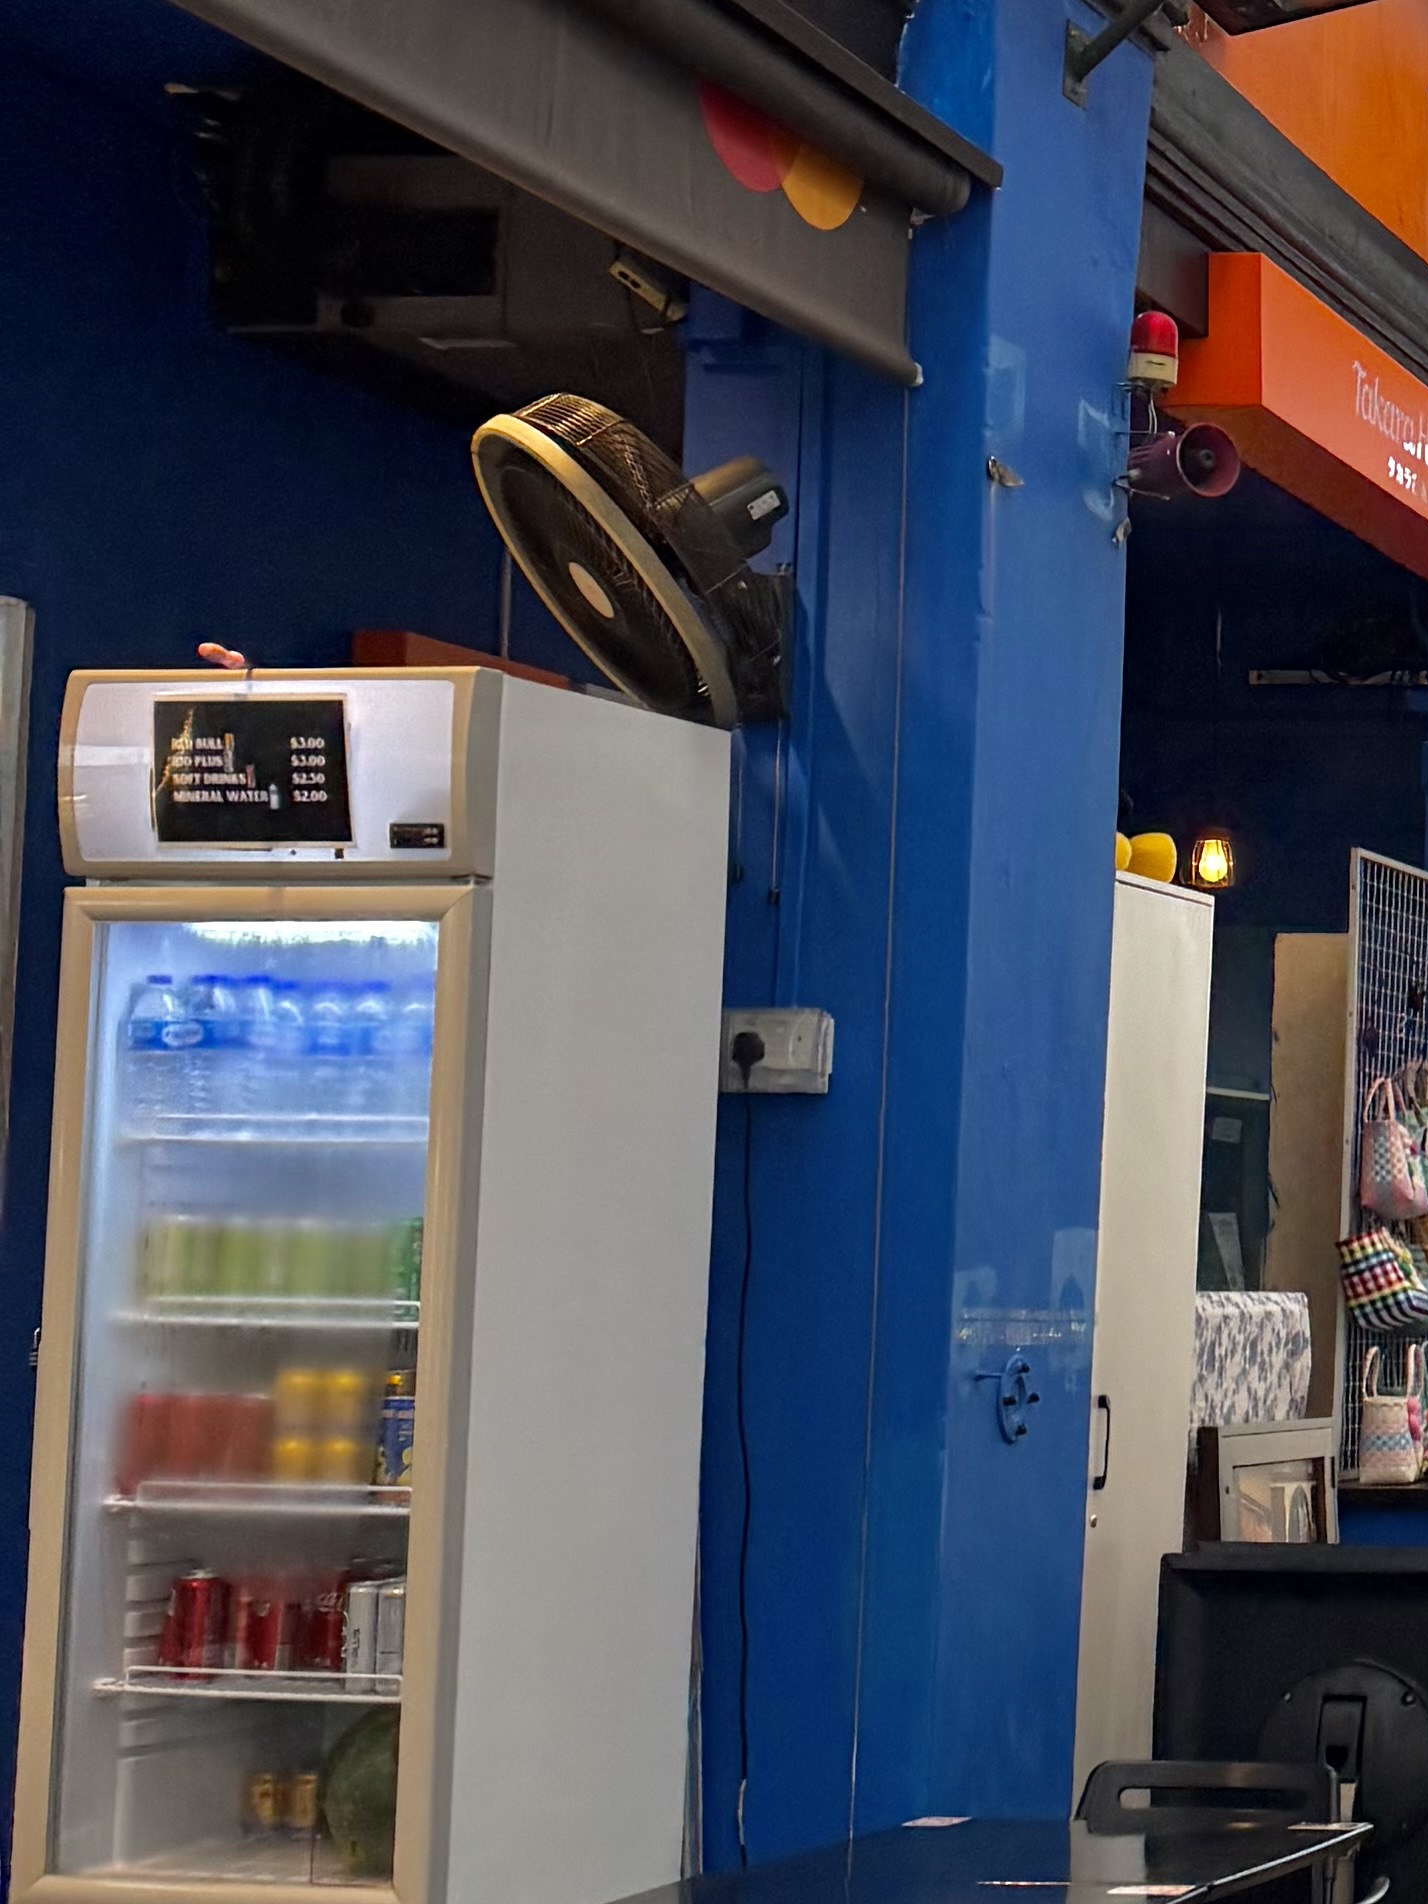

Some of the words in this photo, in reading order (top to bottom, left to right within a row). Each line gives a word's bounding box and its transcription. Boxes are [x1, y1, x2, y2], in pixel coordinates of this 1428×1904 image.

[195, 737, 223, 750] BULL
[195, 755, 223, 767] PLUS
[172, 773, 199, 786] SOFT
[203, 773, 246, 785] DRINKS
[173, 790, 225, 803] MINERAL
[225, 790, 269, 802] WATER
[293, 790, 328, 802] $2.00
